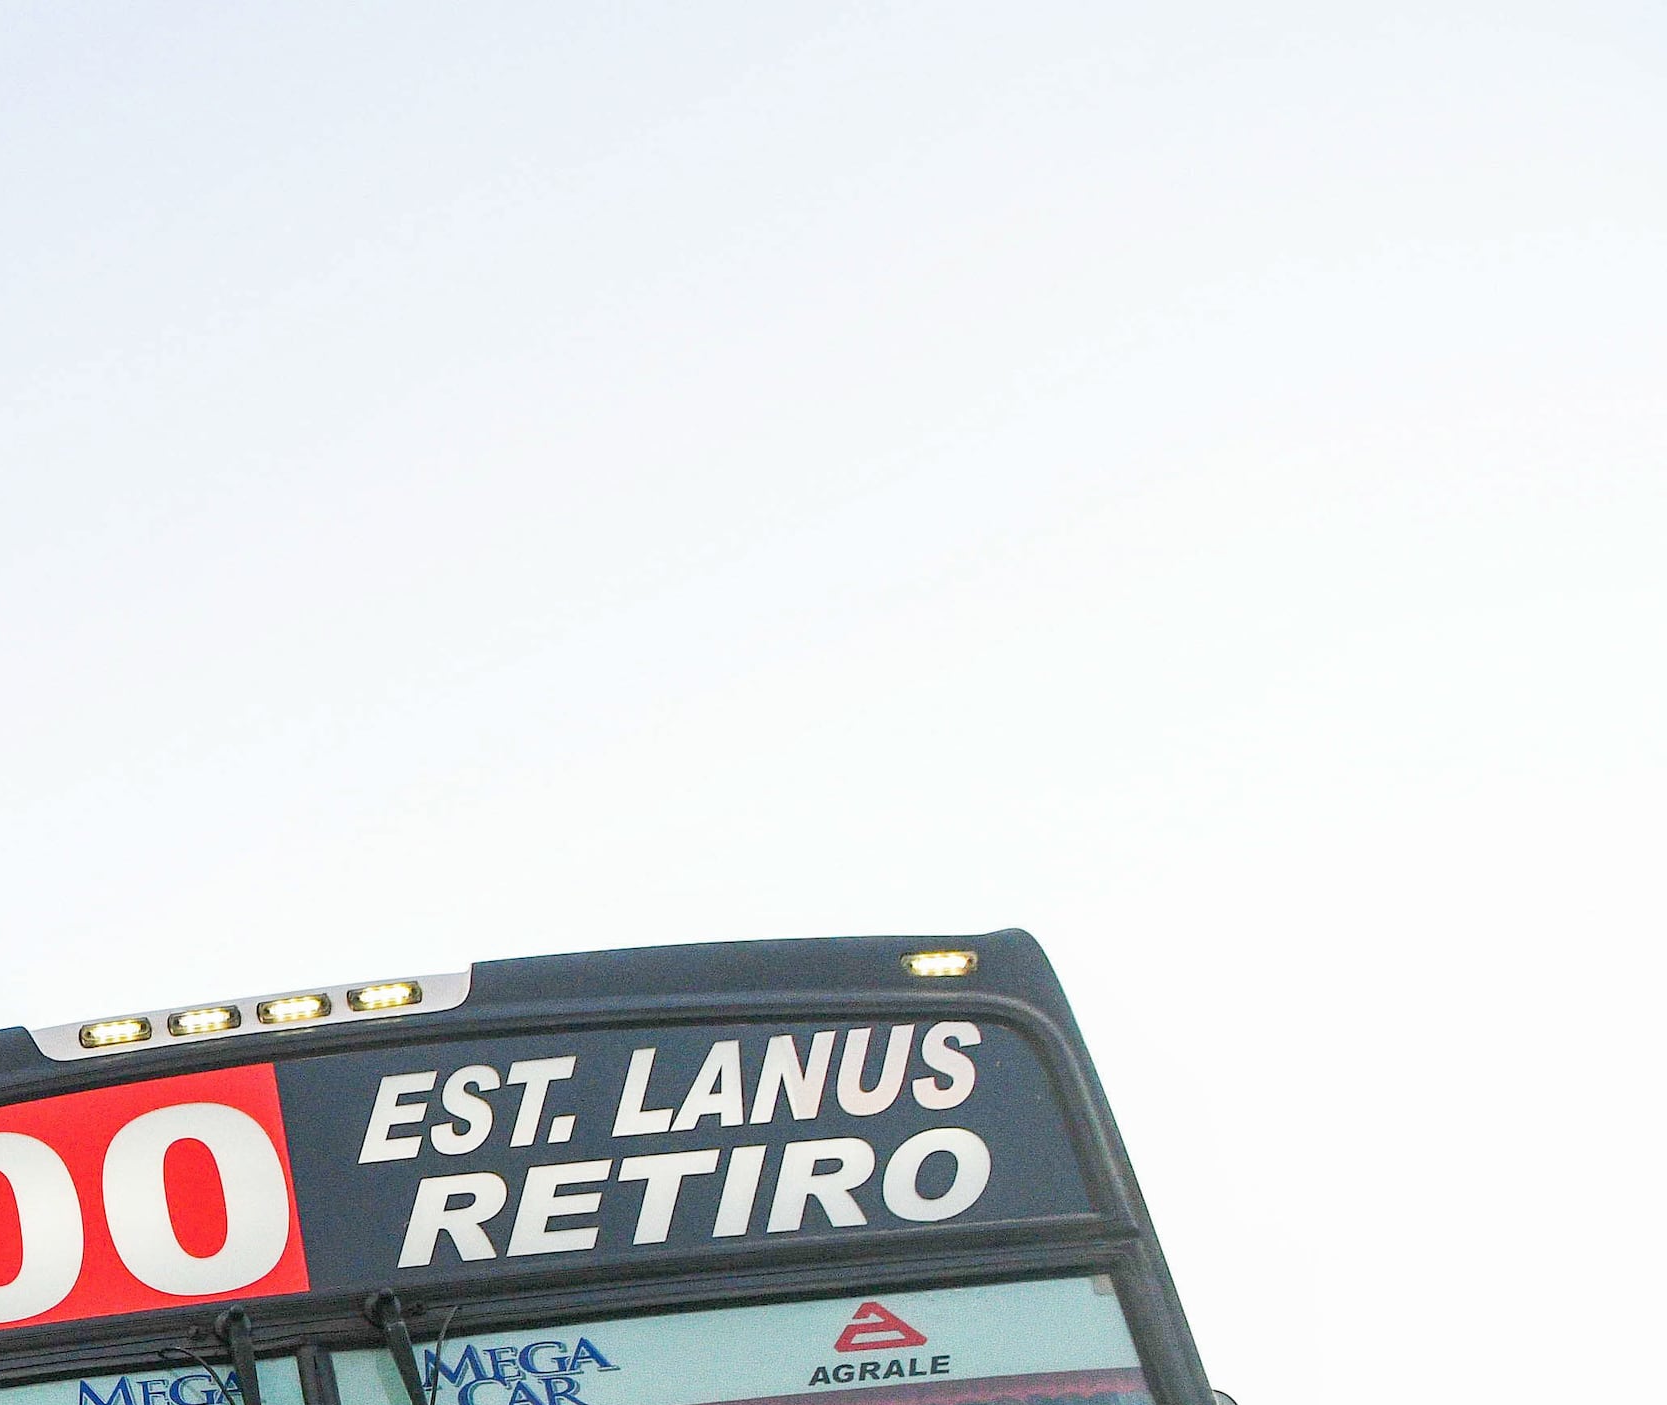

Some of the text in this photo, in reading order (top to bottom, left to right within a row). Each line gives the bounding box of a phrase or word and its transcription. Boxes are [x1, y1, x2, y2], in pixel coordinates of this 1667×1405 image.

[358, 1019, 983, 1165] EST. LANUS
[397, 1126, 992, 1270] RETIRO
[422, 1336, 620, 1391] MEGA
[808, 1354, 950, 1387] AGRALE
